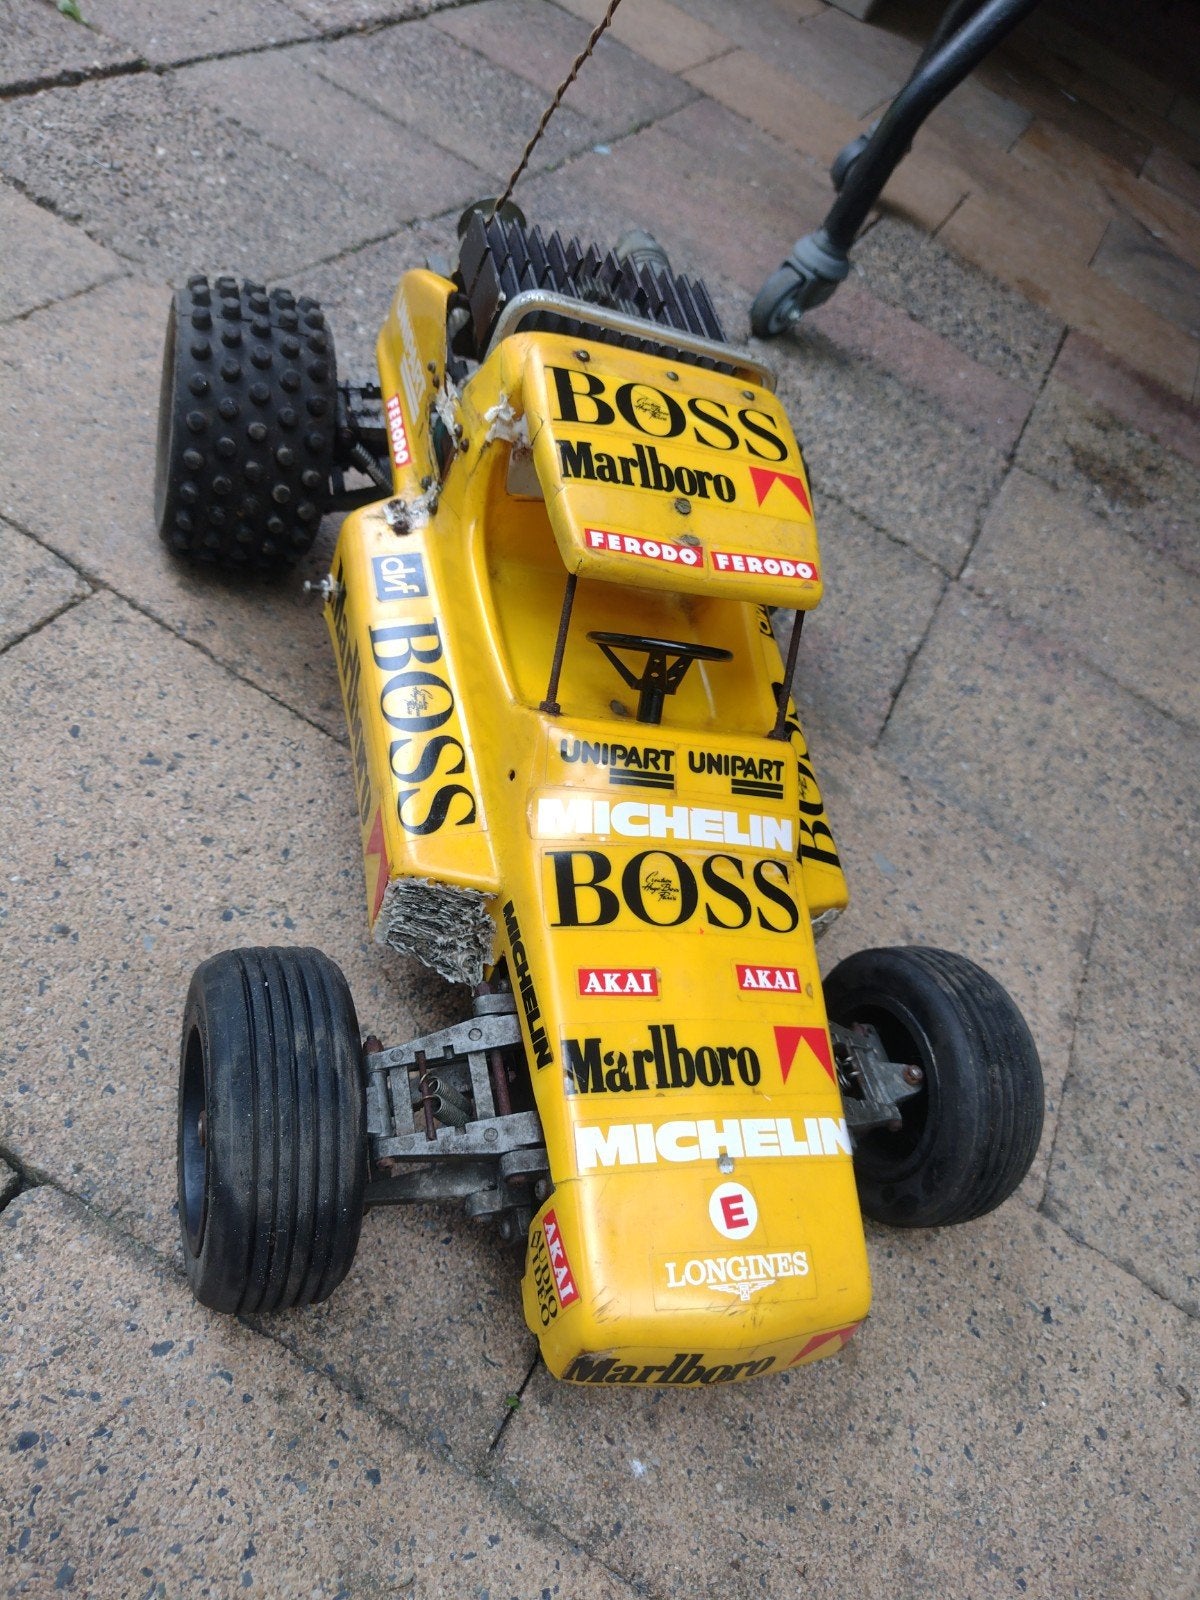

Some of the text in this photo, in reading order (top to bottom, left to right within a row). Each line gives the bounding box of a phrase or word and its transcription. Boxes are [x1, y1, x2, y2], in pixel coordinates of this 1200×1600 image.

[386, 396, 410, 465] FERODO
[552, 366, 789, 463] BOSS
[557, 440, 737, 503] Marlboro
[589, 530, 699, 566] FERODO
[715, 552, 813, 580] FERODO
[368, 617, 477, 836] BOSS
[560, 738, 675, 772] UNIPART
[688, 751, 785, 783] UNIPART
[536, 798, 794, 853] MICHELIN
[545, 849, 800, 934] BOSS
[502, 900, 554, 1070] MICHELIN
[584, 972, 653, 994] AKAI
[742, 968, 798, 991] AKAI
[562, 1025, 761, 1094] Marlboro
[574, 1117, 854, 1169] MICHELIN
[720, 1194, 749, 1229] E
[544, 1222, 574, 1301] AKAI
[665, 1251, 809, 1288] LONGINES
[561, 1353, 777, 1384] Marlboro
